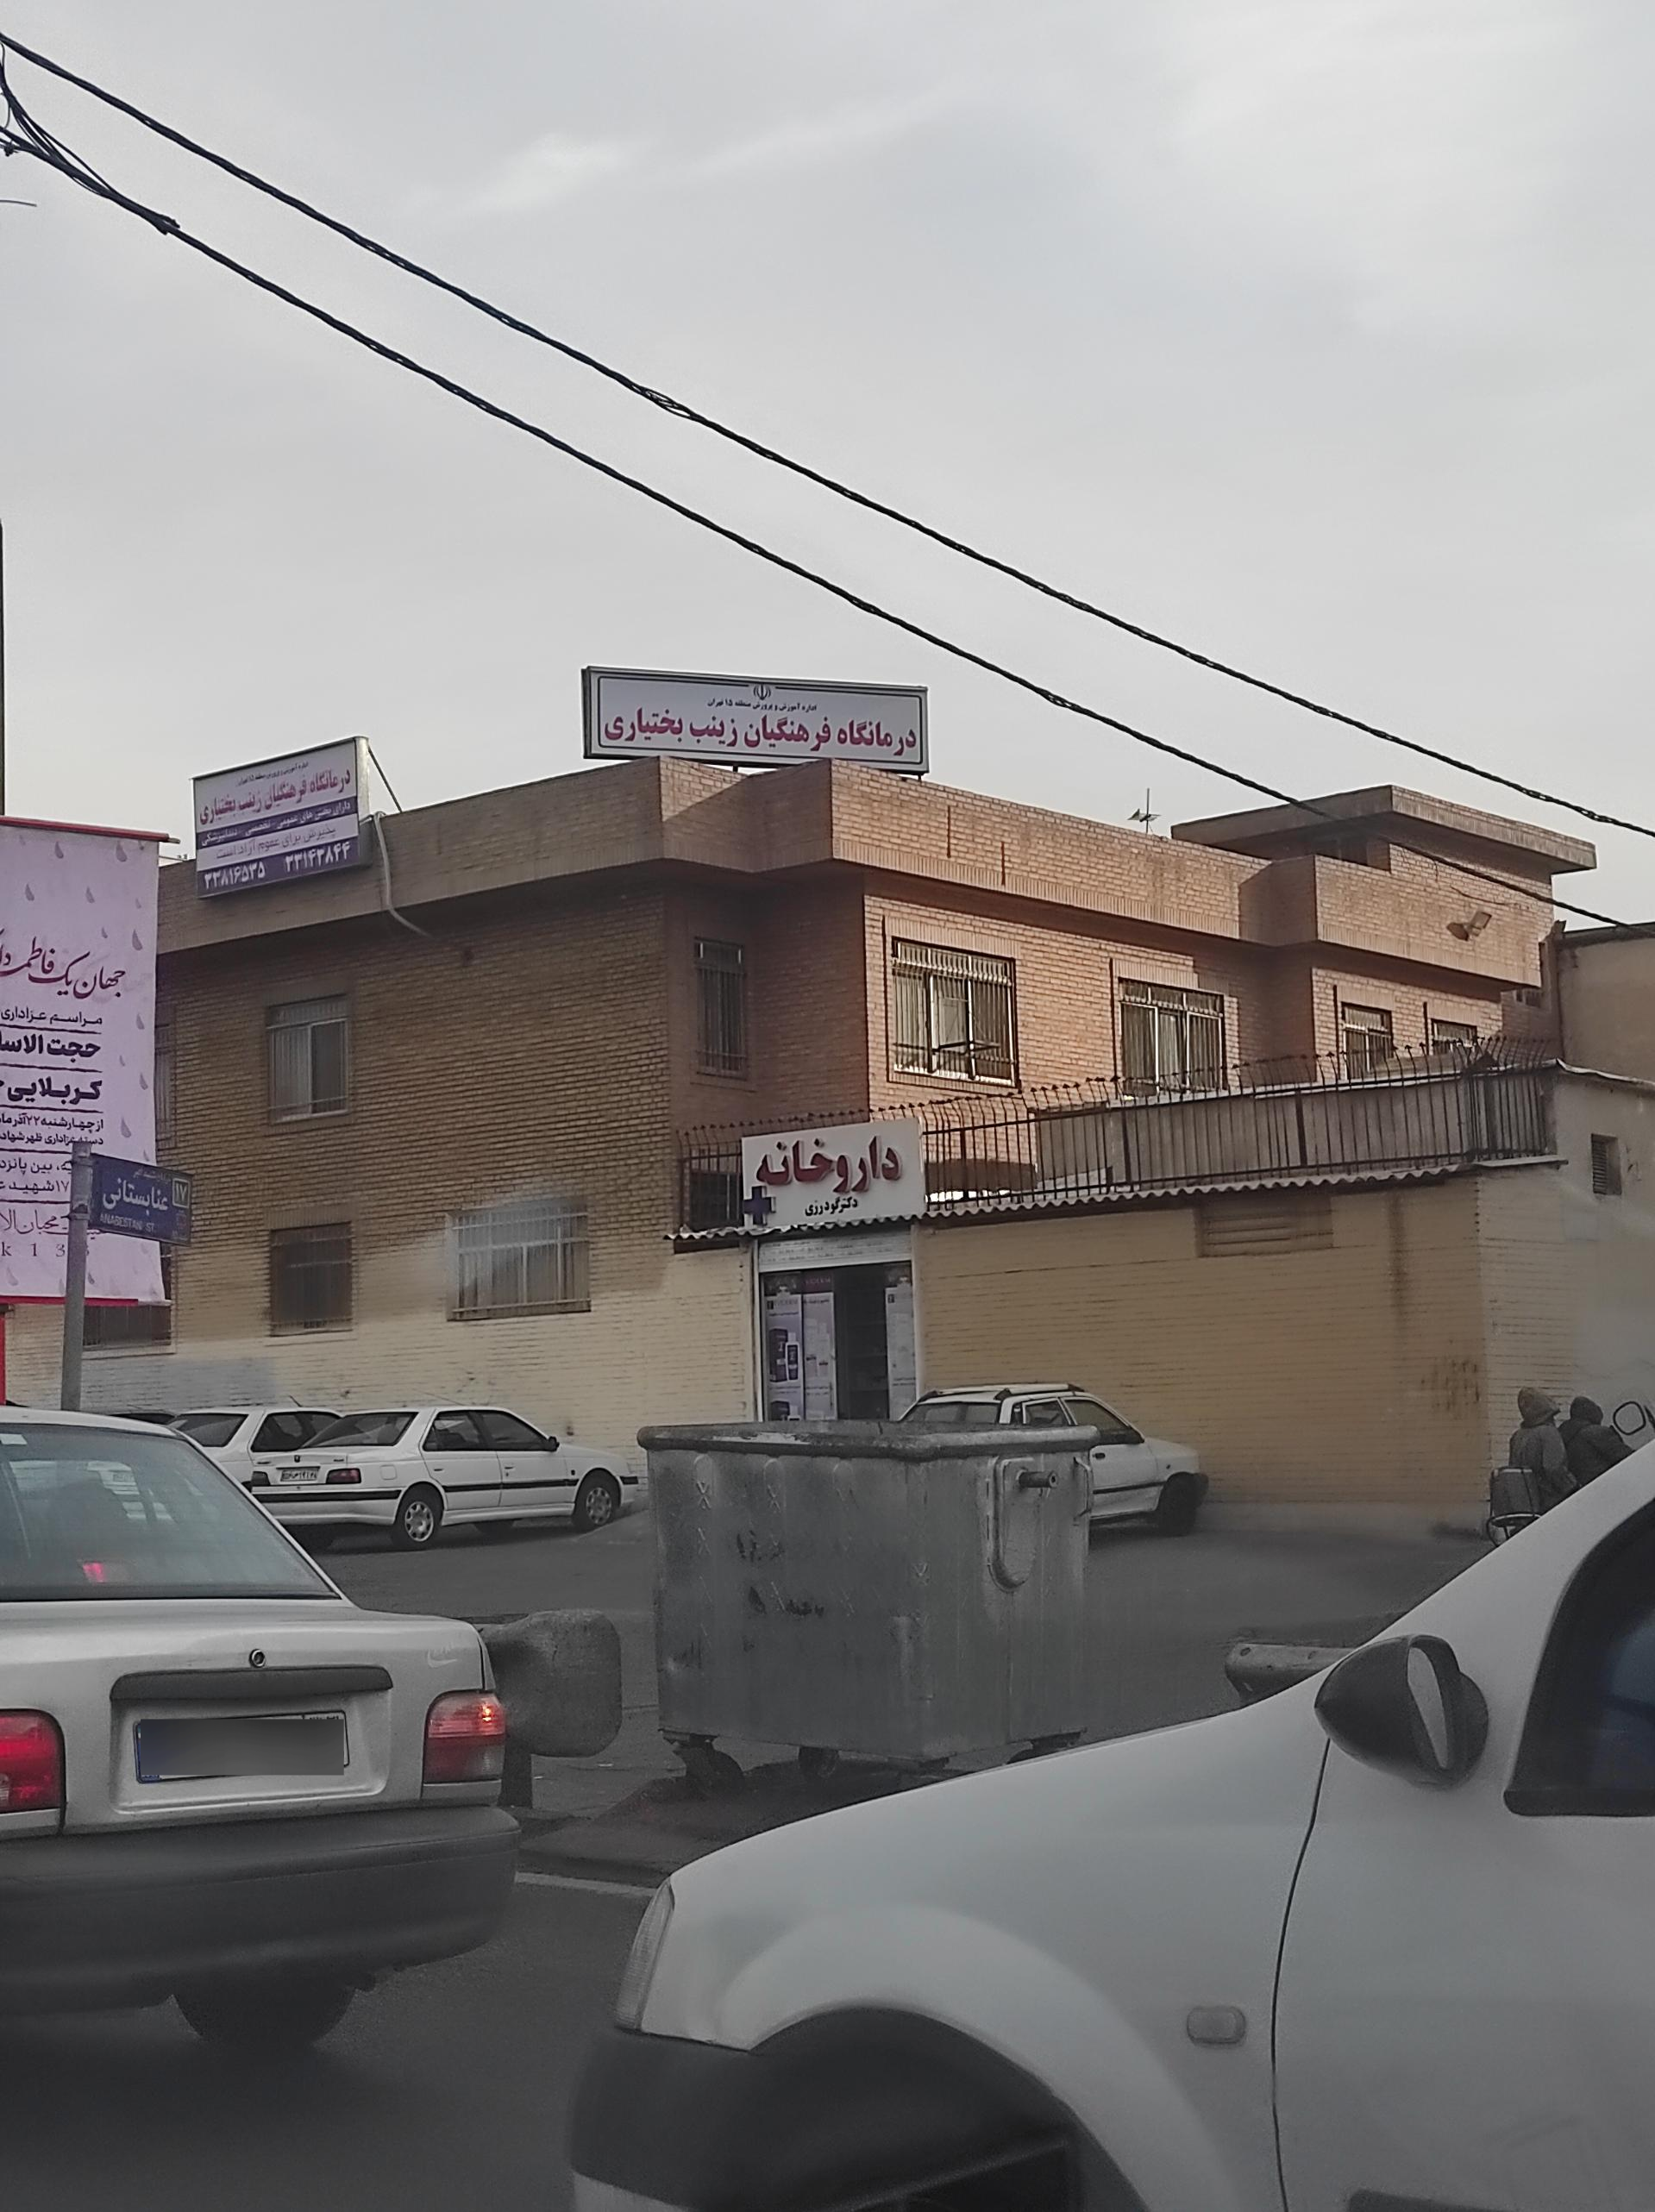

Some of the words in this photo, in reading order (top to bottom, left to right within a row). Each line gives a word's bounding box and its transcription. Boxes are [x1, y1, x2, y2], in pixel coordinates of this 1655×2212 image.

[605, 707, 683, 743] بختیاری
[689, 715, 738, 747] زینب
[744, 713, 831, 751] فرهنگیان
[837, 719, 917, 756] درمانگاه
[310, 768, 351, 794] درمانگاه
[239, 791, 261, 813] زینب
[264, 779, 306, 810] فرهنگیان
[200, 793, 235, 824] بختیاری
[0, 936, 55, 977] فاطم
[28, 951, 90, 995] یک
[73, 967, 126, 999] جهان
[1, 1006, 47, 1023] عزاداری
[49, 1012, 103, 1027] مراسم
[47, 1037, 101, 1063] حجت
[7, 1075, 103, 1105] کربلایی
[0, 1131, 25, 1143] شهاد
[25, 1132, 42, 1144] ظهر
[45, 1133, 77, 1145] عزاداری
[0, 1156, 27, 1175] پانزد
[31, 1162, 53, 1174] بین
[755, 1135, 902, 1193] داروخانه
[9, 1180, 54, 1194] شهید
[103, 1177, 168, 1216] عنابستانی
[176, 1181, 187, 1201] ۱۷
[805, 1196, 840, 1217] گودرزی
[838, 1196, 858, 1213] دکتر
